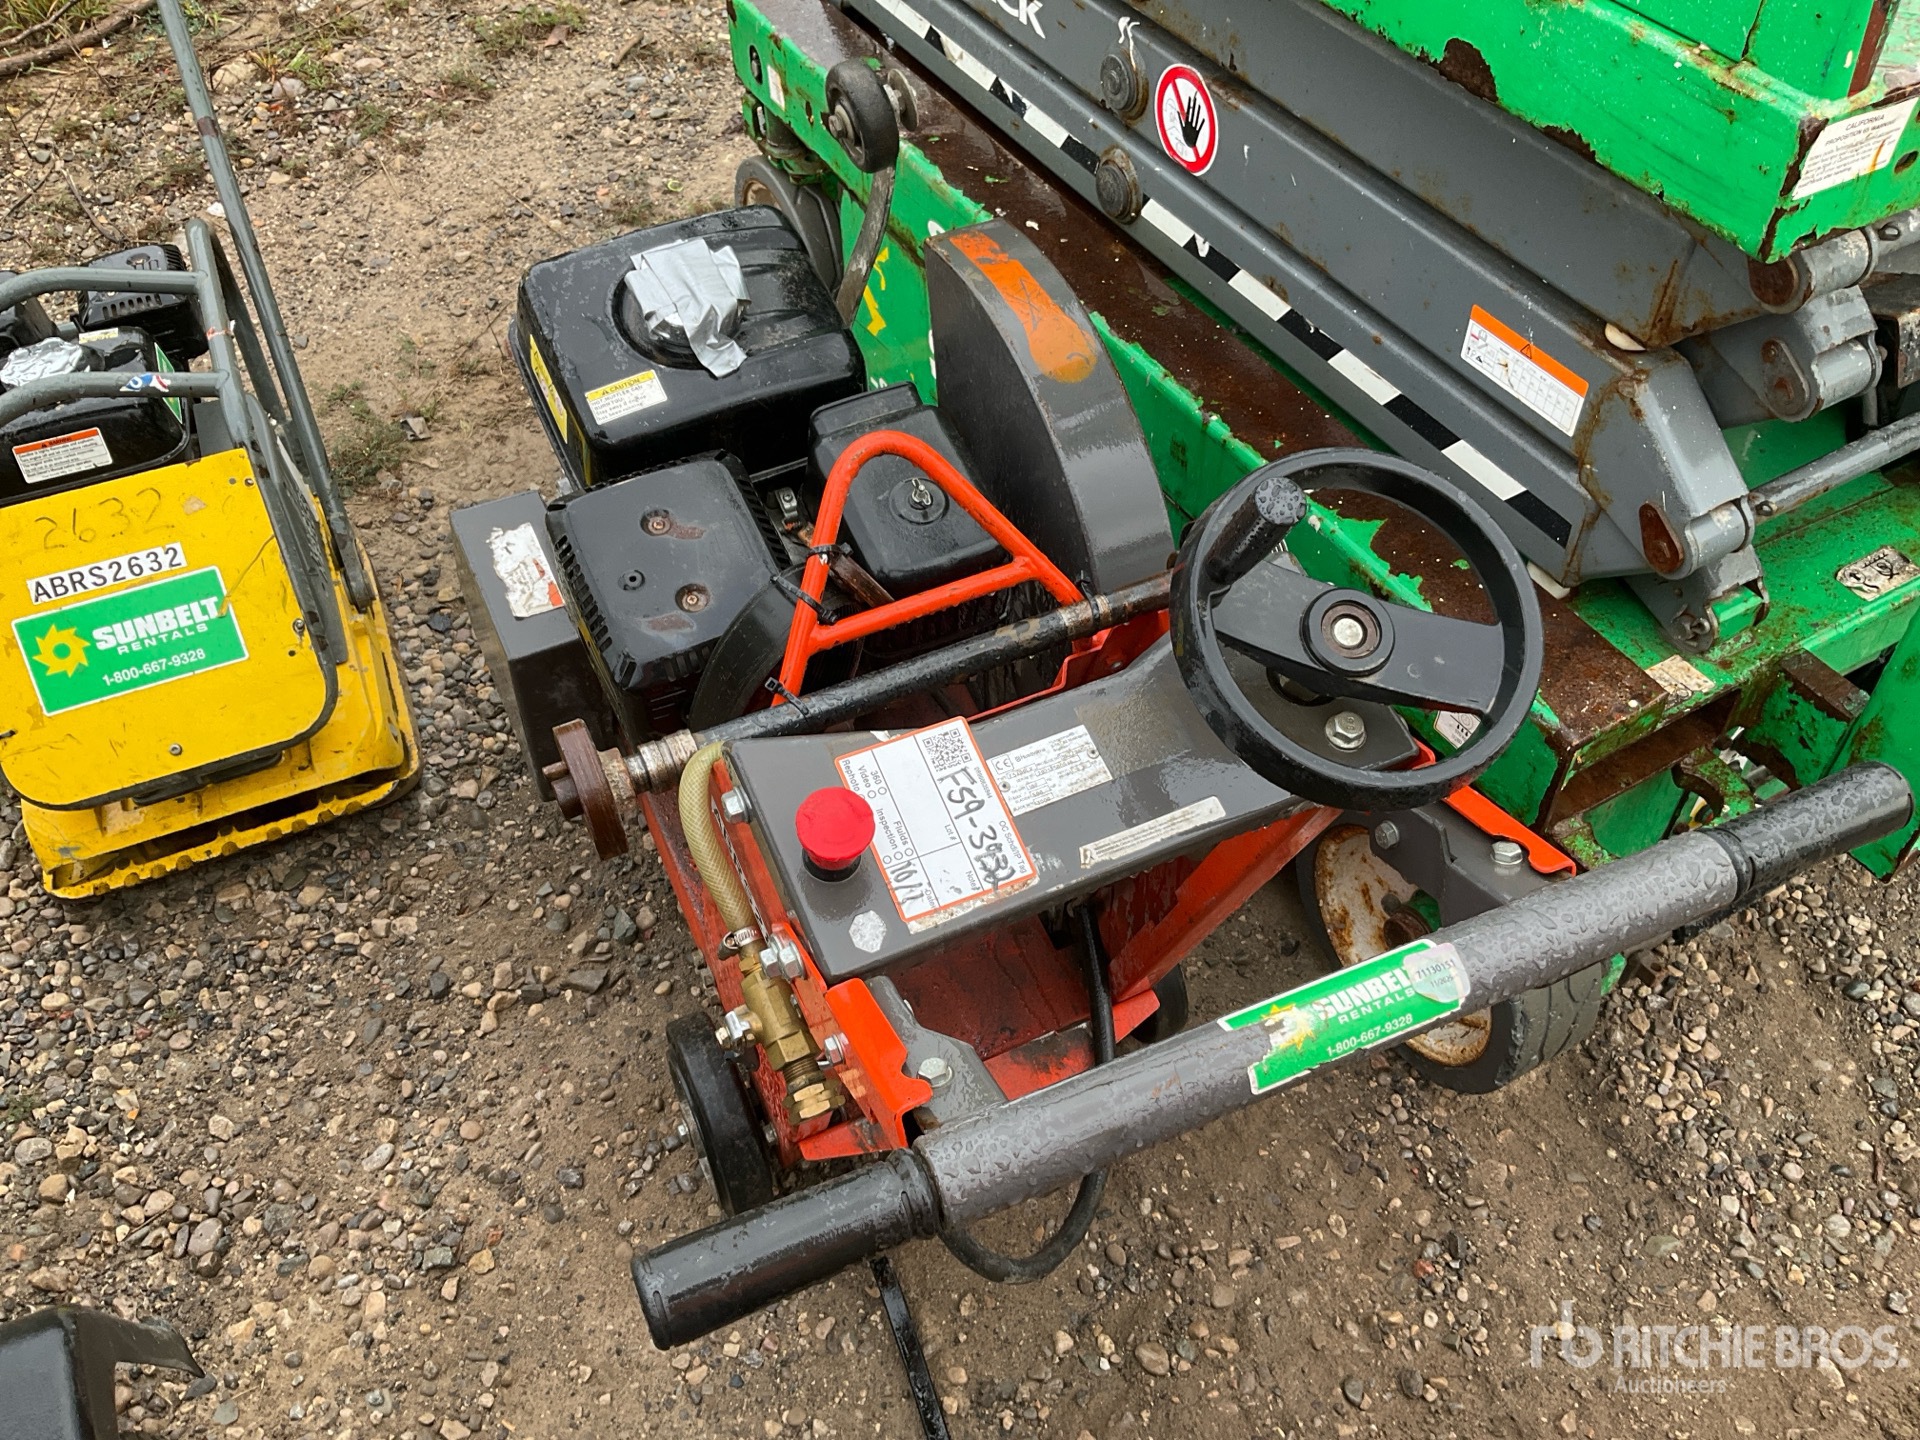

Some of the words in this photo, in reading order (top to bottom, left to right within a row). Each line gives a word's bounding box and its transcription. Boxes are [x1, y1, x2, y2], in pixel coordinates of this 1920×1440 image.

[1846, 114, 1885, 131] CALIFORNIA
[610, 378, 640, 392] CAUTION
[34, 488, 175, 549] 2632
[33, 546, 182, 603] ABRS2632
[92, 596, 219, 650] SUNBELT
[116, 623, 208, 656] RENTALS
[101, 647, 206, 687] 1-800-667-9328
[843, 760, 861, 792] Rephoto
[857, 765, 871, 788] Video
[870, 769, 882, 785] 360
[876, 808, 898, 850] Inspection
[893, 820, 909, 846] Fluids
[944, 824, 953, 836] Lot
[1016, 861, 1027, 874] Tag
[1338, 988, 1416, 1025] RENTALS
[1326, 1013, 1413, 1057] 1-800-667-9328
